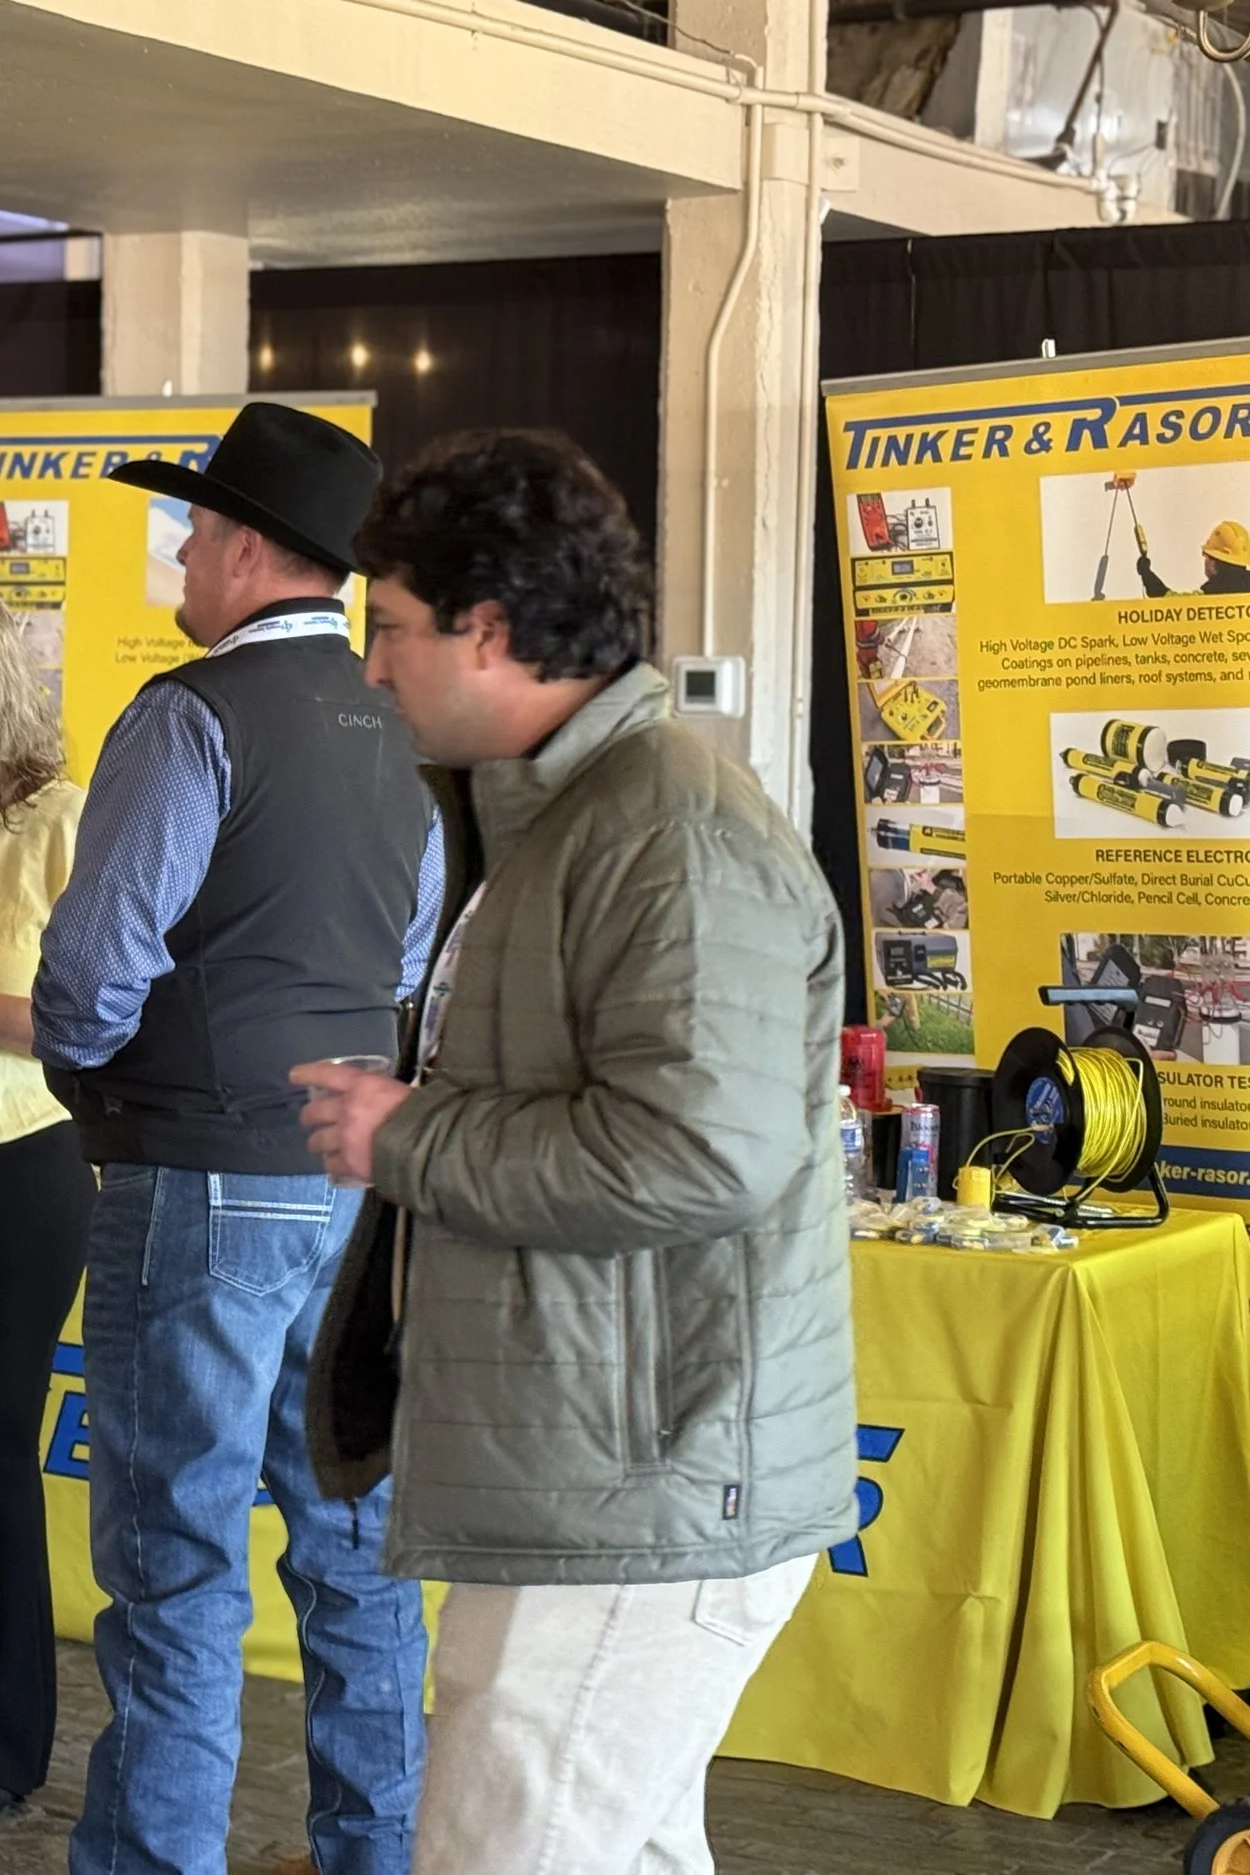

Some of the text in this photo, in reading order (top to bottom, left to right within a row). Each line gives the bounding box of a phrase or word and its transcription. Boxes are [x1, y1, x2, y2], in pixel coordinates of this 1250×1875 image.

[843, 418, 1013, 470] TINKER
[1023, 421, 1053, 456] &
[1118, 608, 1182, 624] HOLIDAY
[980, 640, 1007, 655] High
[1010, 638, 1054, 653] Voltage
[1058, 636, 1077, 649] DC
[1081, 634, 1119, 651] Spark,
[1123, 634, 1148, 647] Low
[1151, 632, 1196, 647] Voltage
[1199, 630, 1223, 643] Wet
[1001, 656, 1053, 671] Coatings
[1056, 658, 1071, 668] on
[1075, 653, 1131, 670] pipelines,
[1135, 651, 1170, 666] tanks,
[1174, 650, 1227, 665] concrete,
[977, 667, 1243, 692] geomembrane pond liners, roof systems, and
[338, 713, 382, 729] CINCH
[1095, 849, 1182, 863] REFERENCE
[993, 872, 1042, 885] Portable
[1045, 871, 1138, 888] Copper/Sulfate,
[1141, 872, 1176, 886] Direct
[1180, 872, 1214, 887] Burial
[1044, 890, 1250, 906] Silver/Chloride, Pencil Cell, Concre
